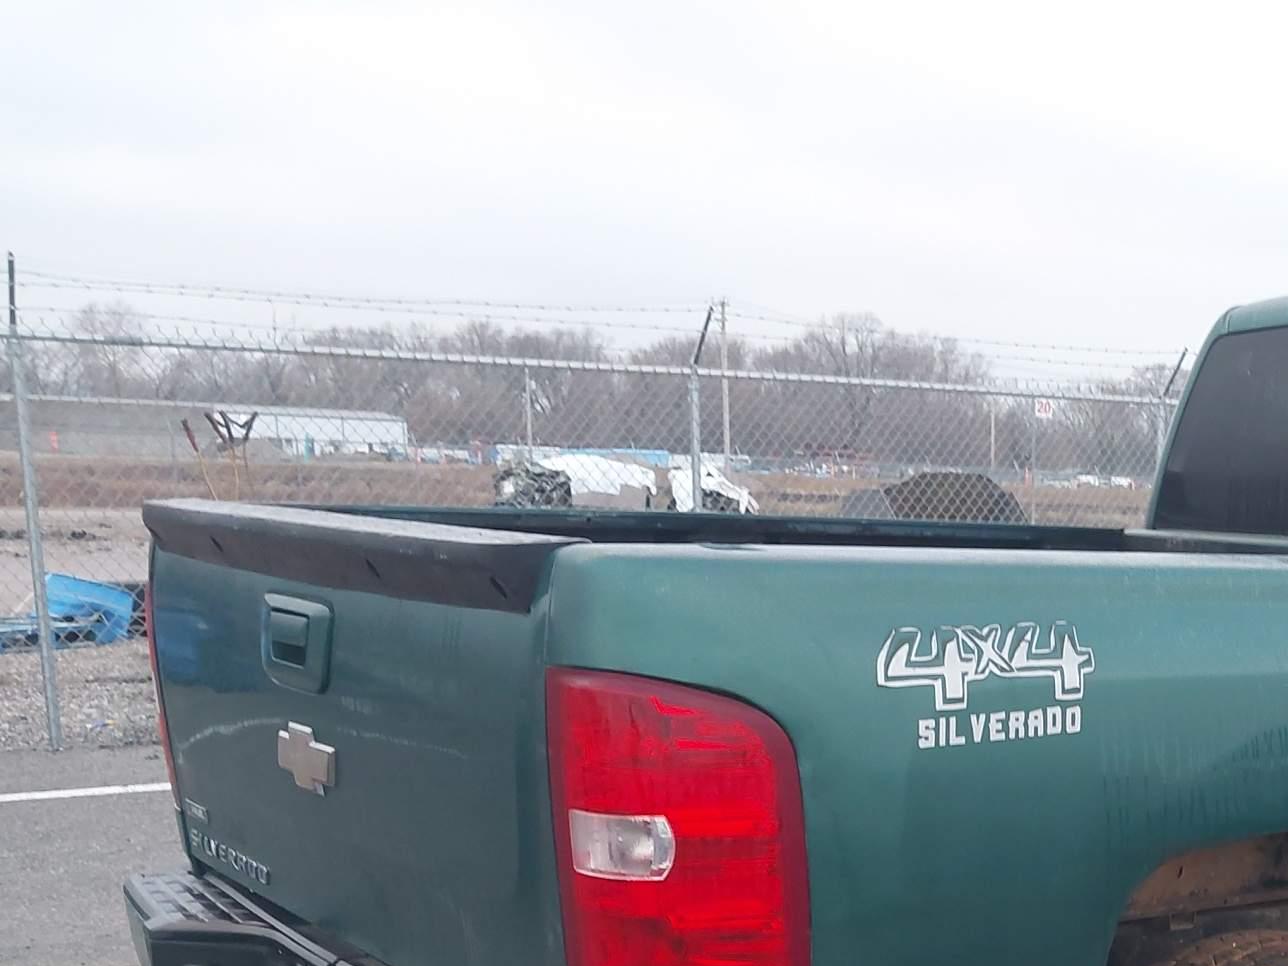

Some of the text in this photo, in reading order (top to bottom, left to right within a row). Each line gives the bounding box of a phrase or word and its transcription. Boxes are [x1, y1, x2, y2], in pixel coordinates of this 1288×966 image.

[1036, 400, 1052, 414] 20
[918, 705, 1082, 749] SILVERADO
[190, 828, 271, 885] SILVERADO
